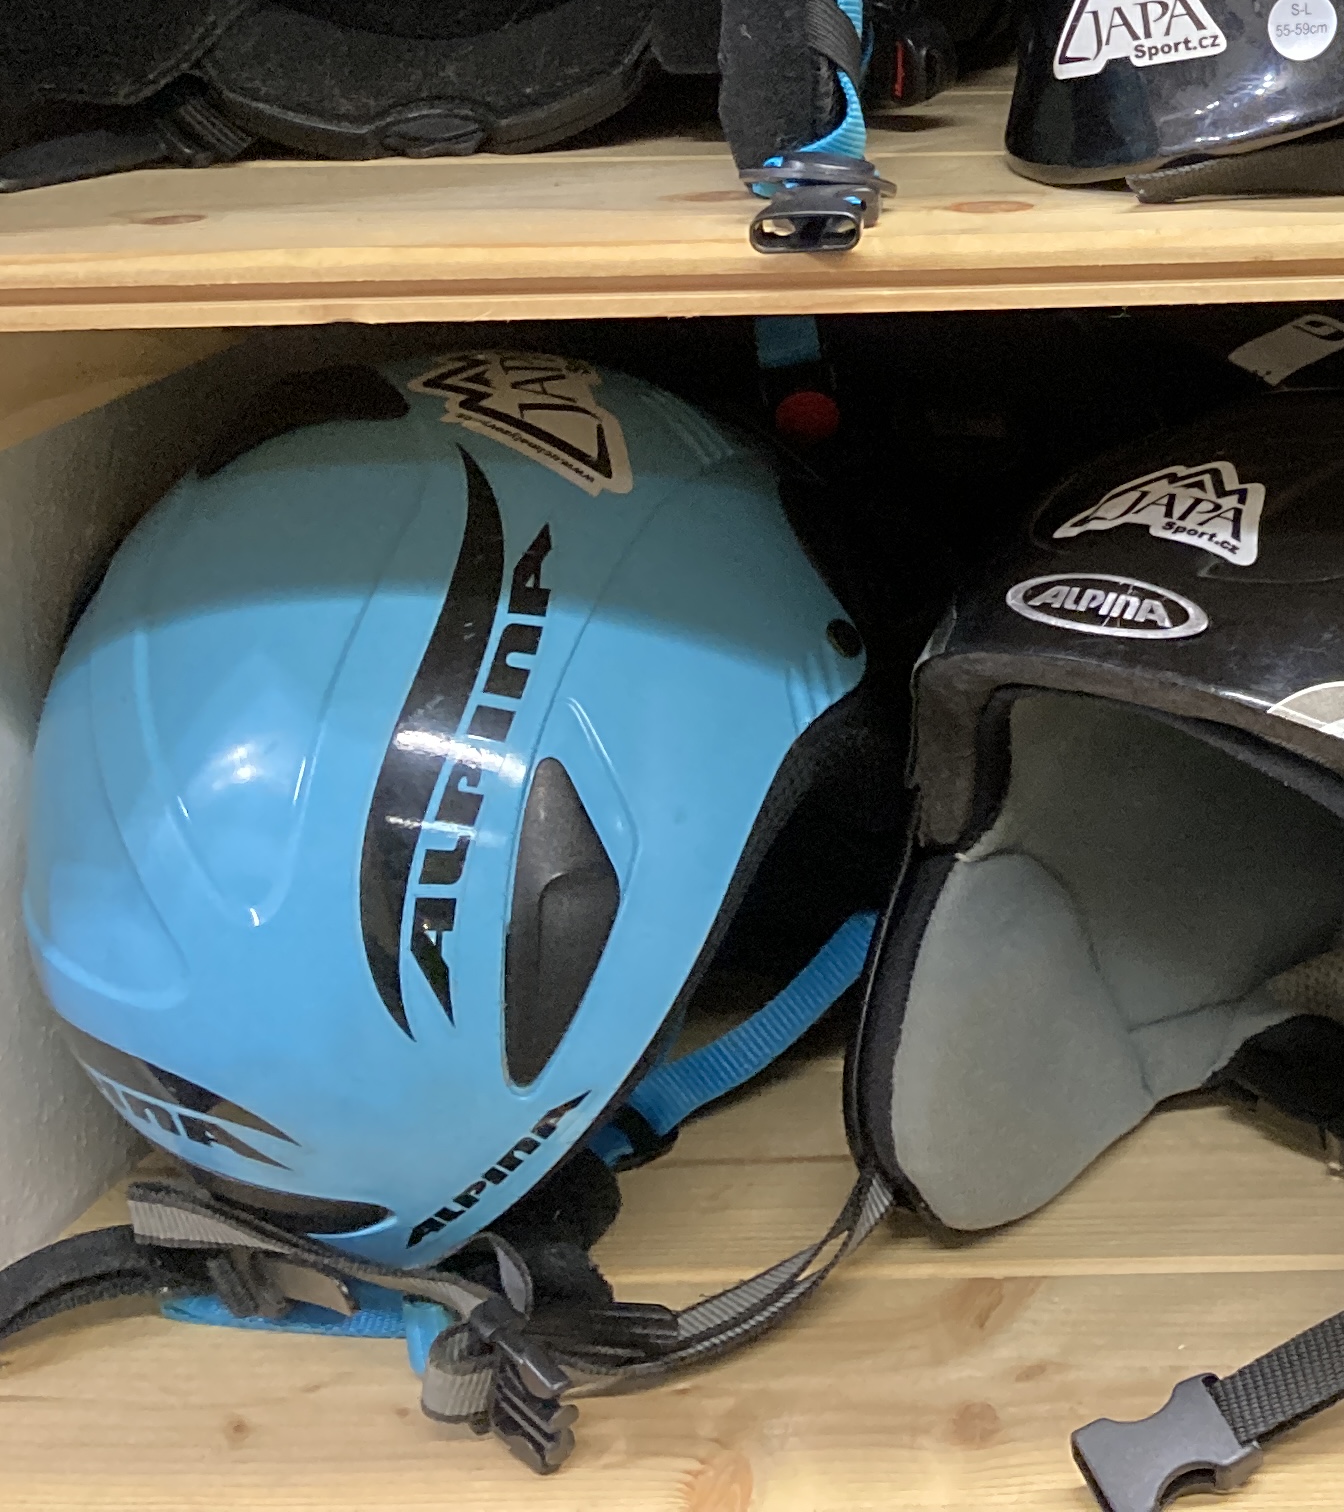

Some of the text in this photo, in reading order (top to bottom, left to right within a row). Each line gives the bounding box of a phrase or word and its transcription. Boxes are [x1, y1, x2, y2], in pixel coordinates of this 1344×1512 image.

[1290, 2, 1313, 17] S-L
[1134, 34, 1221, 61] Sport.cz
[1275, 21, 1329, 38] 55-59cm
[1107, 490, 1244, 543] JAPA
[1161, 520, 1240, 555] Sport.cz
[1027, 584, 1173, 628] ALPINA
[410, 522, 553, 1028] ALPINA
[406, 1089, 593, 1250] ALPINA
